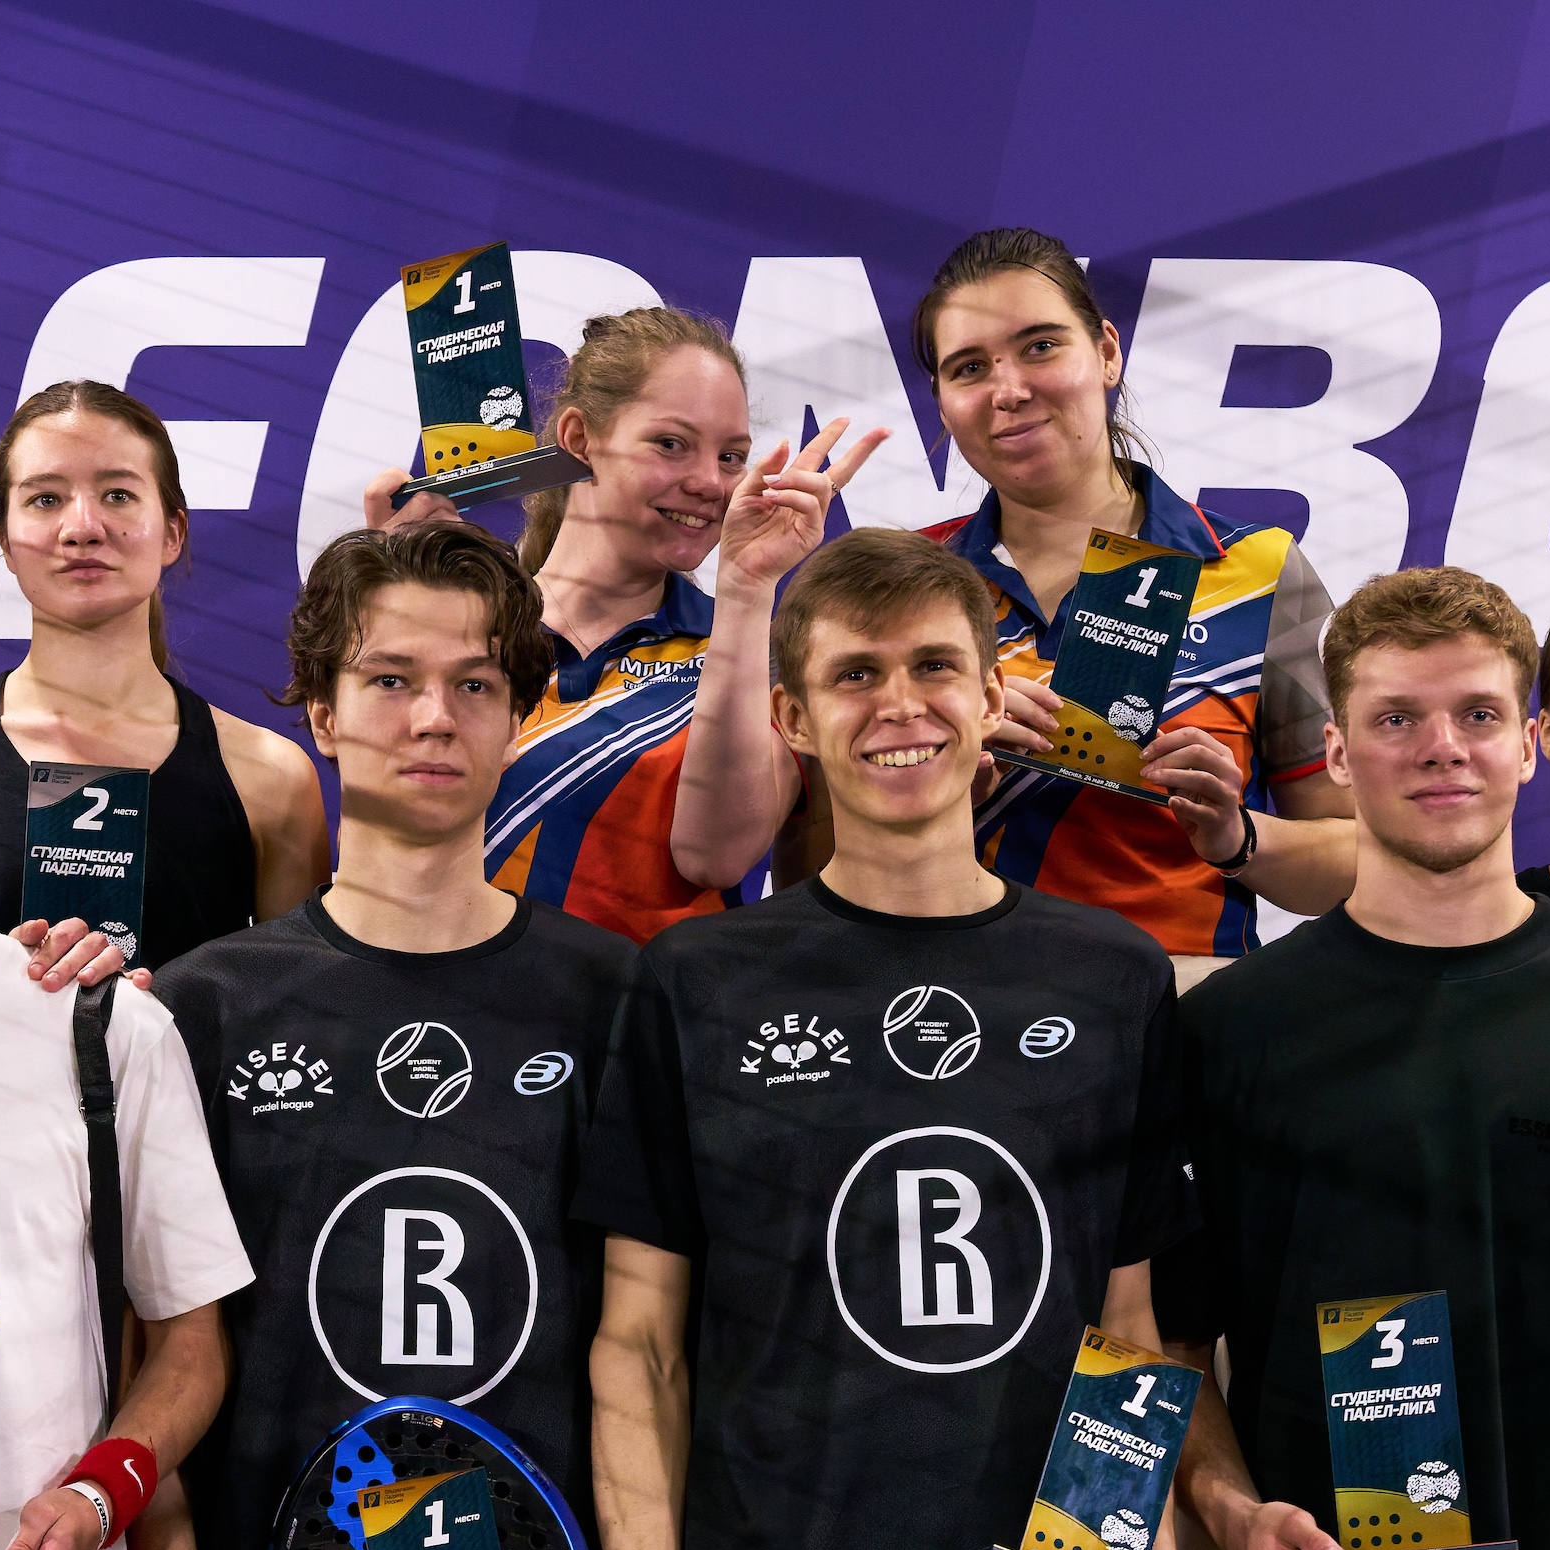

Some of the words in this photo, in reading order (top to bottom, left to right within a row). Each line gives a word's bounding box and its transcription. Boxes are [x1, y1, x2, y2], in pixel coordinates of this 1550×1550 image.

[453, 270, 476, 315] 1
[480, 281, 501, 292] место
[416, 320, 505, 354] СТУДЕНЧЕСКАЯ
[427, 335, 501, 364] ПАДЕЛ-ЛИГА
[1125, 566, 1159, 609] 1
[1159, 589, 1182, 600] место
[1074, 610, 1170, 645] СТУДЕНЧЕСКАЯ
[1079, 625, 1159, 657] ПАДЕЛ-ЛИГА
[1177, 649, 1198, 662] ЛУБ
[680, 675, 699, 683] КЛУ
[72, 787, 110, 831] 2
[113, 807, 138, 816] место
[30, 846, 134, 864] СТУДЕНЧЕСКАЯ
[39, 860, 126, 878] ПАДЕЛ-ЛИГА
[914, 1021, 950, 1029] STUDENT
[740, 1013, 851, 1075] KISELEV
[227, 1042, 334, 1101] KISELEV
[410, 1073, 439, 1081] LEAGUE
[765, 1072, 795, 1087] padel
[796, 1069, 830, 1083] league
[252, 1102, 279, 1116] padel
[280, 1100, 314, 1113] league
[1371, 1318, 1406, 1369] 3
[1411, 1336, 1439, 1346] место
[1120, 1373, 1158, 1418] 1
[1156, 1398, 1181, 1414] место
[1330, 1383, 1442, 1408] СТУДЕНЧЕСКАЯ
[1343, 1400, 1436, 1423] ПАДЕЛ-ЛИГА
[1067, 1410, 1167, 1460] СТУДЕНЧЕСКАЯ
[1073, 1429, 1156, 1472] ПАДЕЛ-ЛИГА
[423, 1500, 450, 1548] 1
[454, 1512, 480, 1525] место
